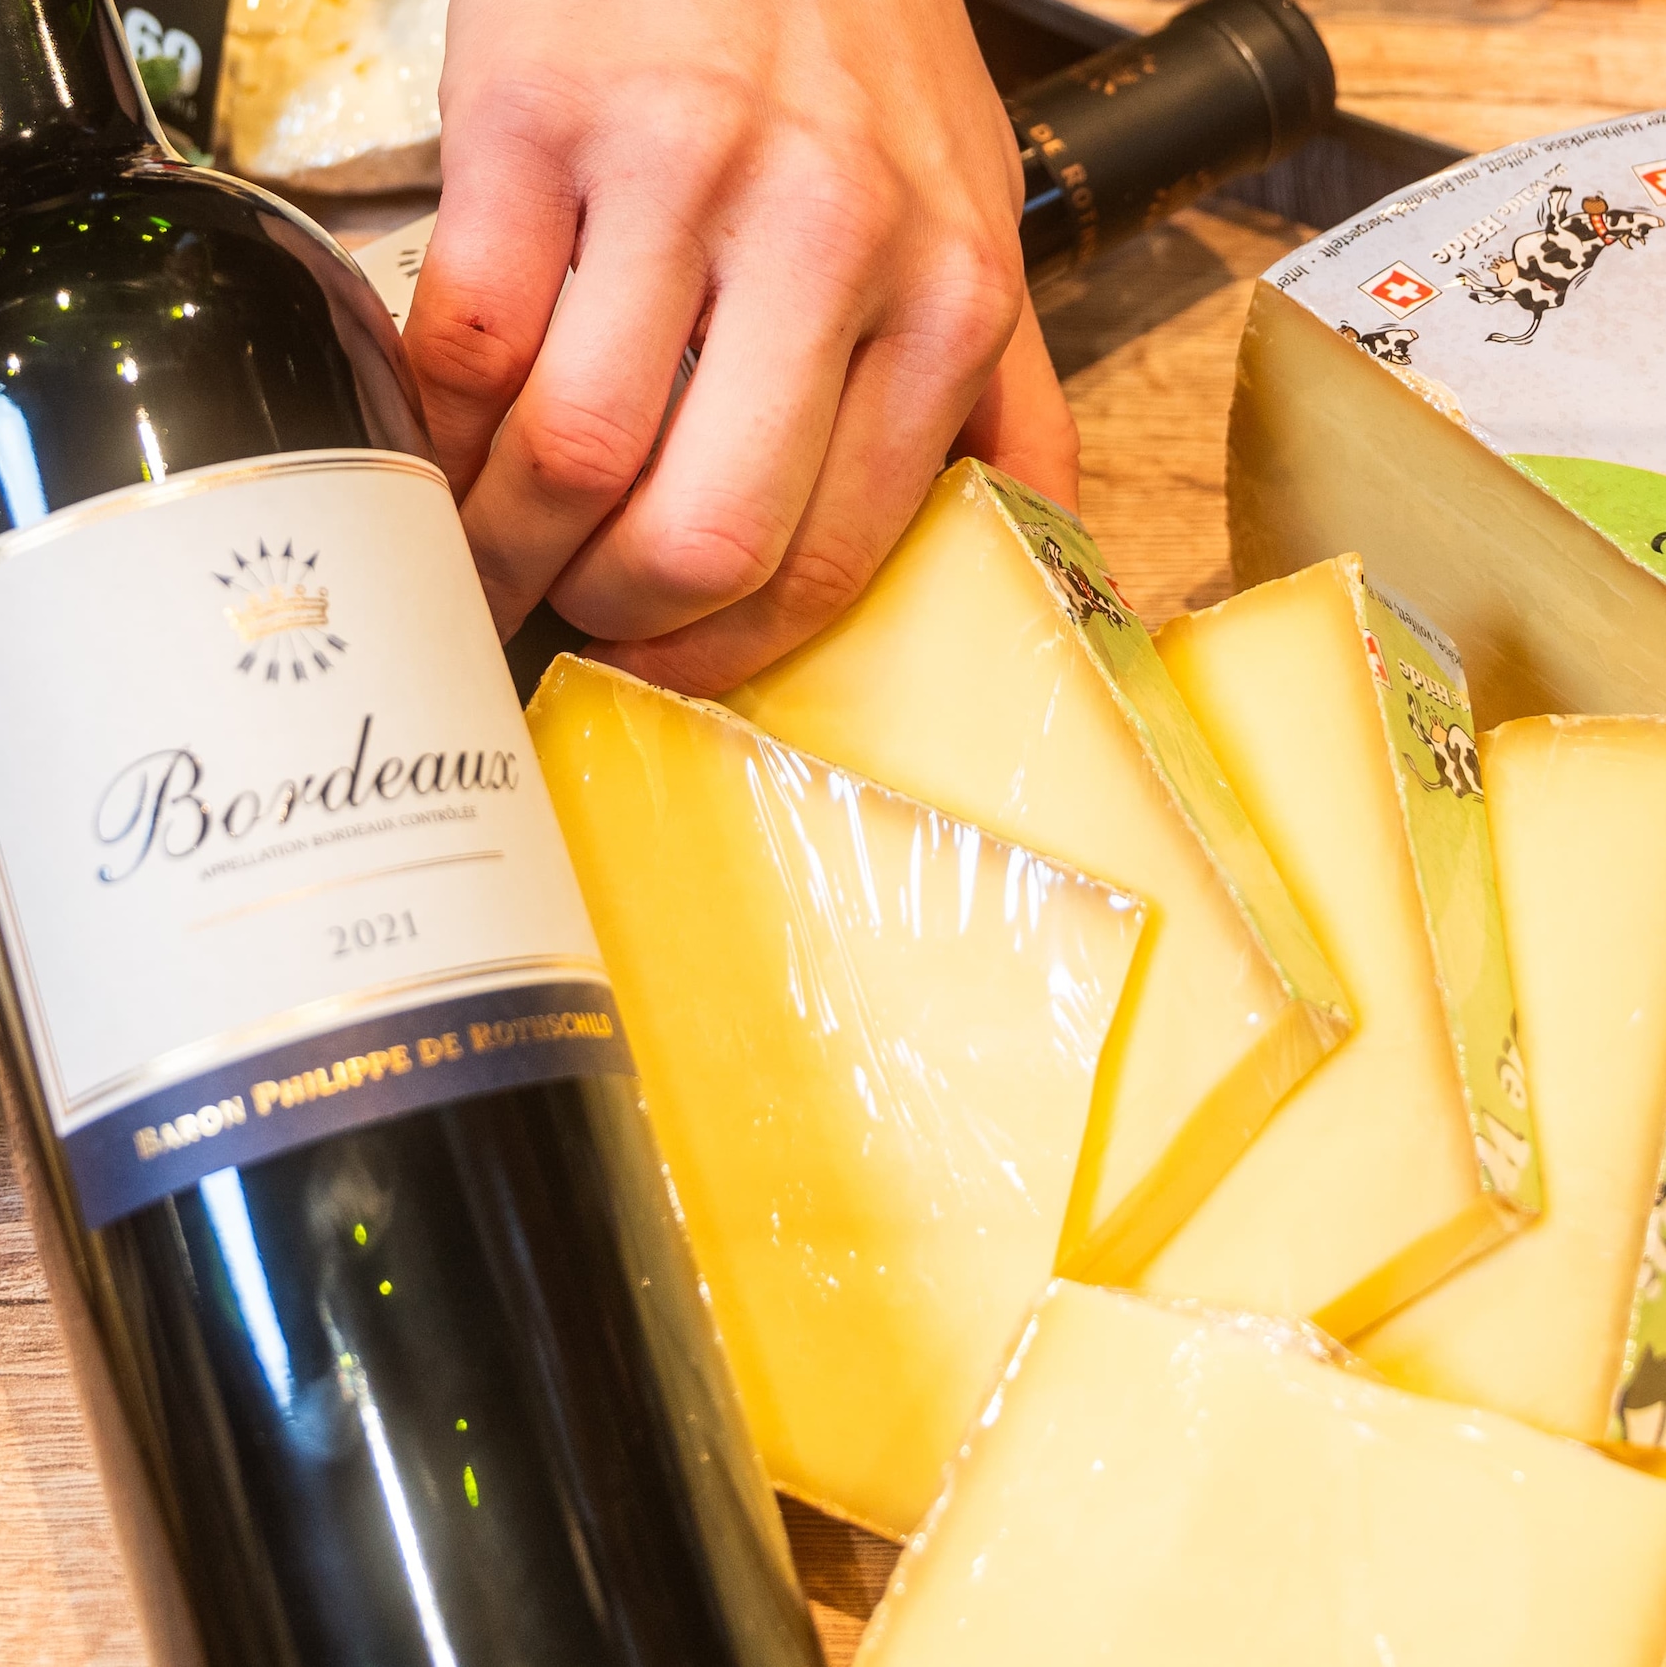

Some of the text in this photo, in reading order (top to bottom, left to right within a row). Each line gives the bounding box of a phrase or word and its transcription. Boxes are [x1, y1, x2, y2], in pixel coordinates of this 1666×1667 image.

[1533, 116, 1645, 160] Halbhartkäse,
[1432, 209, 1509, 268] Hilde
[92, 713, 520, 883] Bordeaux
[194, 797, 479, 886] APPELLATION BORDEAUX CONTRÔLÉE
[325, 905, 422, 957] 2021
[136, 1008, 615, 1162] BARON PHILIPPE DE ROTHSCHILD
